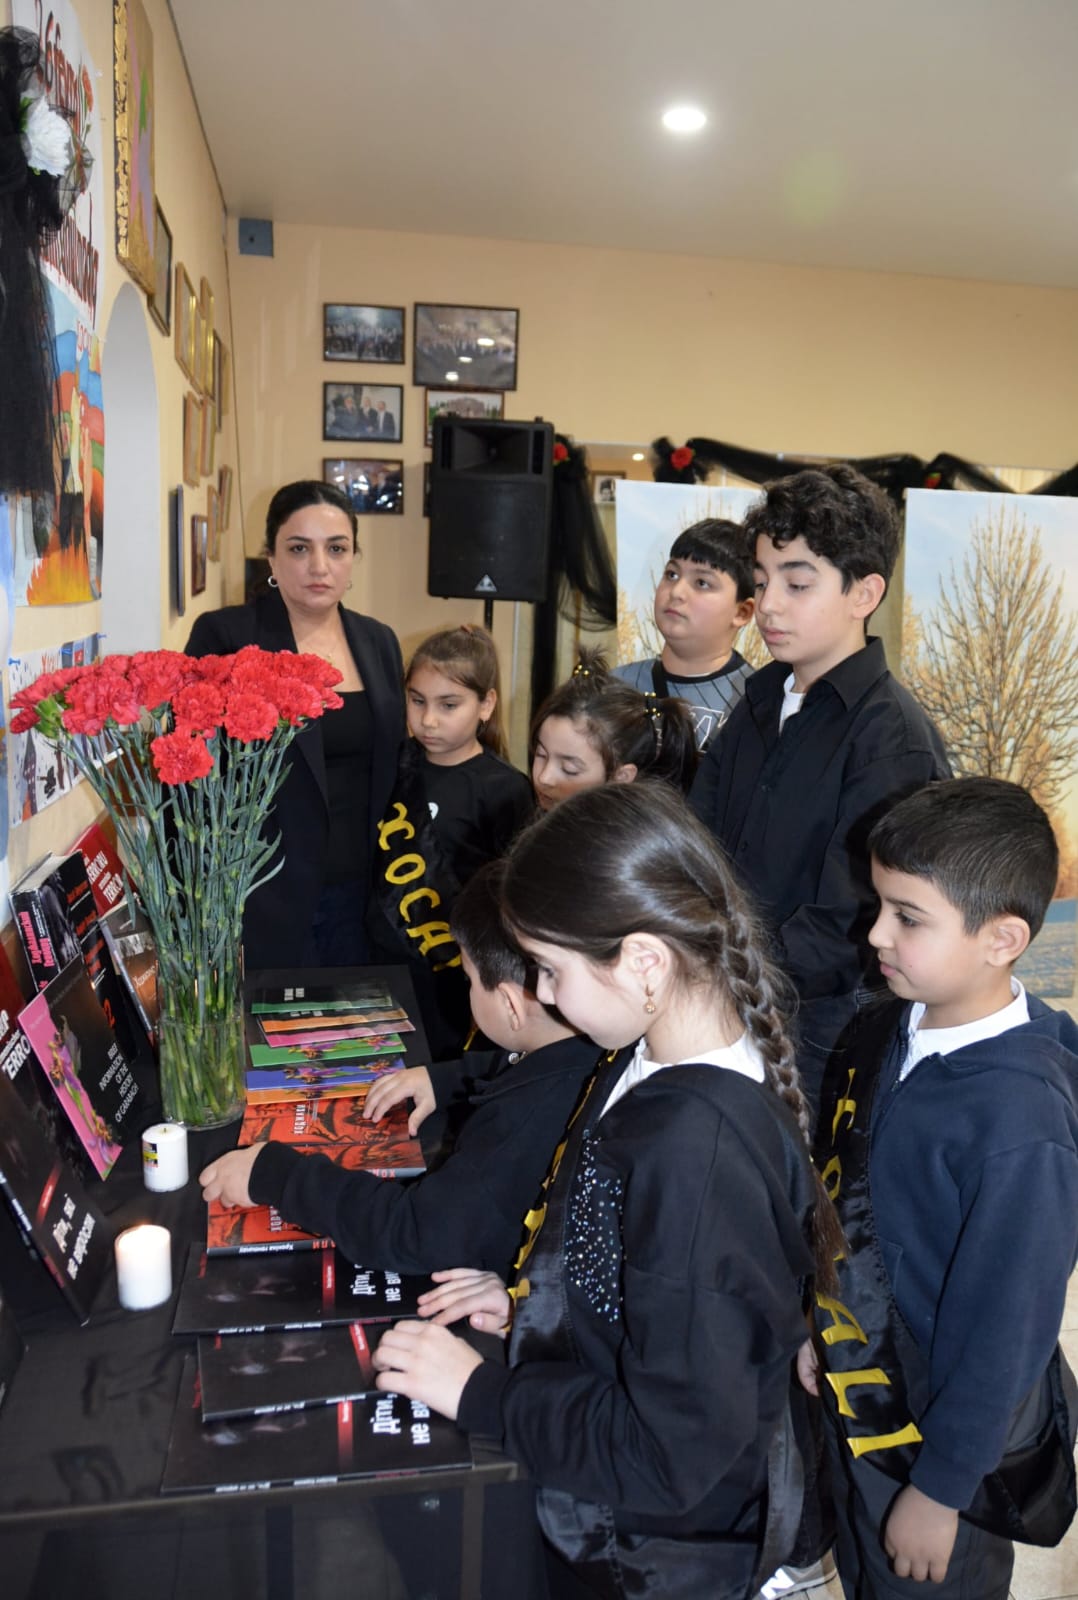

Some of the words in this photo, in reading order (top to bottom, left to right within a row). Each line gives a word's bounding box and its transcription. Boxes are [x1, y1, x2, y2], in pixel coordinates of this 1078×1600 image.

[99, 1054, 124, 1091] INFORMATION
[119, 1071, 134, 1098] HISTORY
[350, 1270, 376, 1296] Діти,
[384, 1287, 401, 1302] не
[370, 1393, 402, 1435] Діти,
[411, 1423, 431, 1445] не
